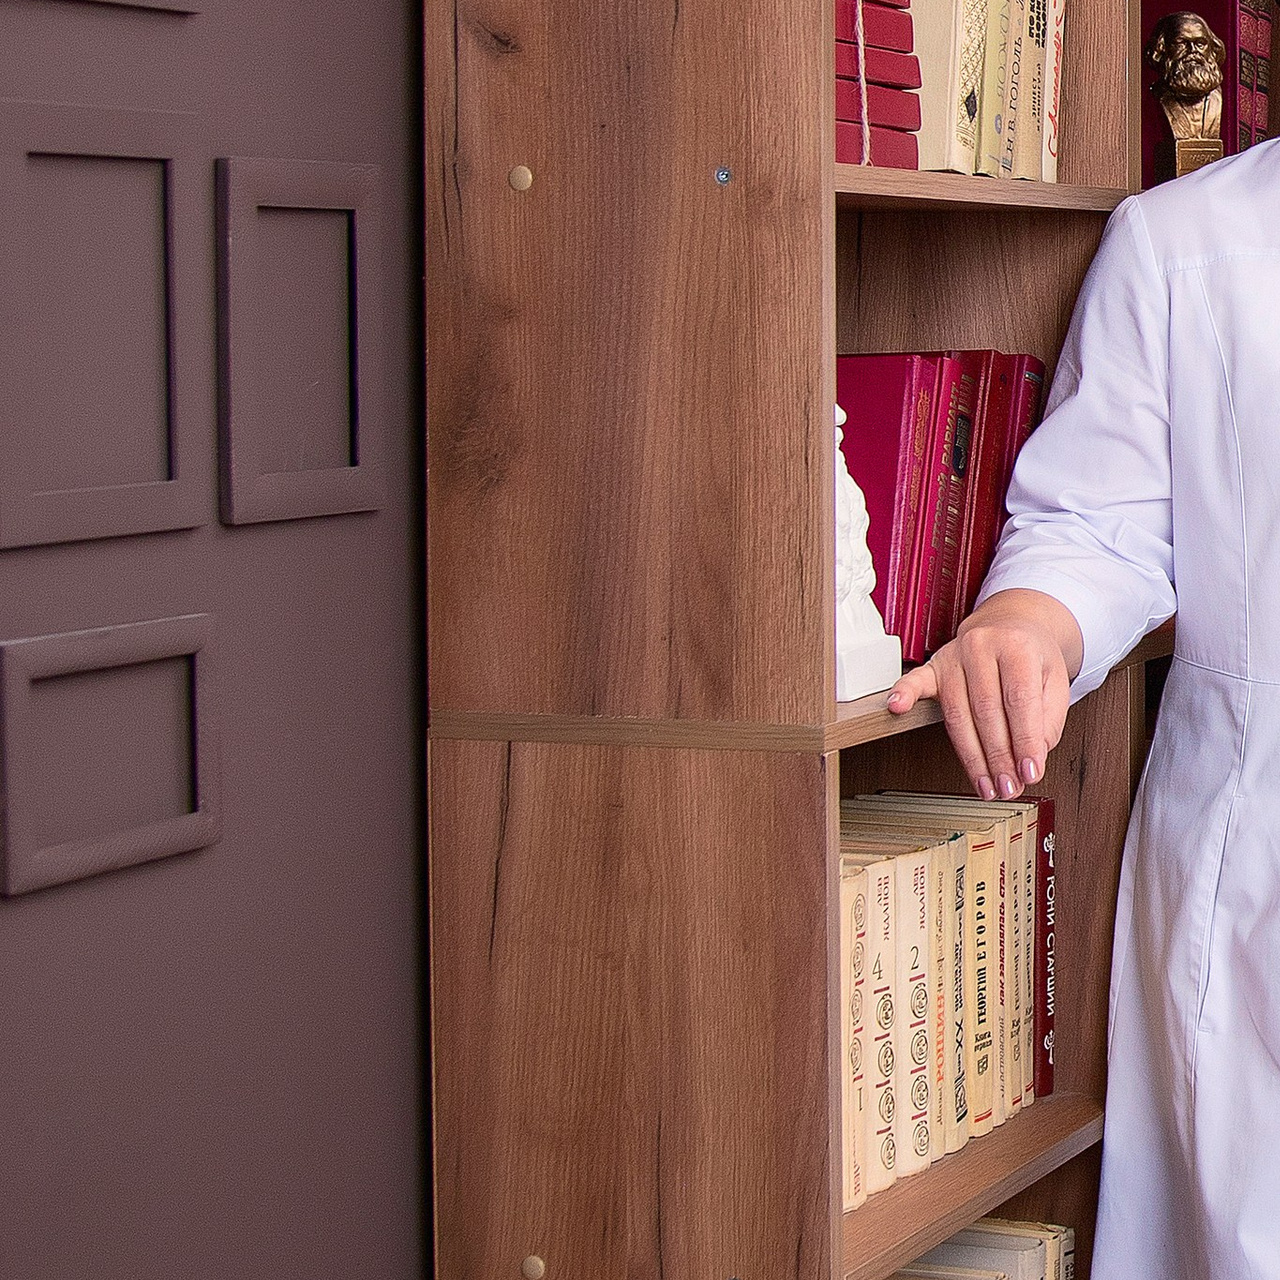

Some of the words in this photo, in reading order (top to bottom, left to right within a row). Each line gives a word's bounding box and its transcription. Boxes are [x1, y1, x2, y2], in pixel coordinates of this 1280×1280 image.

[1028, 12, 1037, 38] ПО
[1009, 35, 1024, 113] ГОГОЛЬ
[931, 470, 948, 549] ВТОРОЙ
[941, 381, 959, 468] ВАРИАНТ
[975, 880, 987, 958] ЕГОРОВ
[1045, 874, 1055, 925] РОНИ
[871, 951, 885, 982] 4
[909, 944, 922, 973] 2
[976, 960, 988, 1026] ГЕОРГИЙ
[934, 992, 947, 1085] РОЩИН
